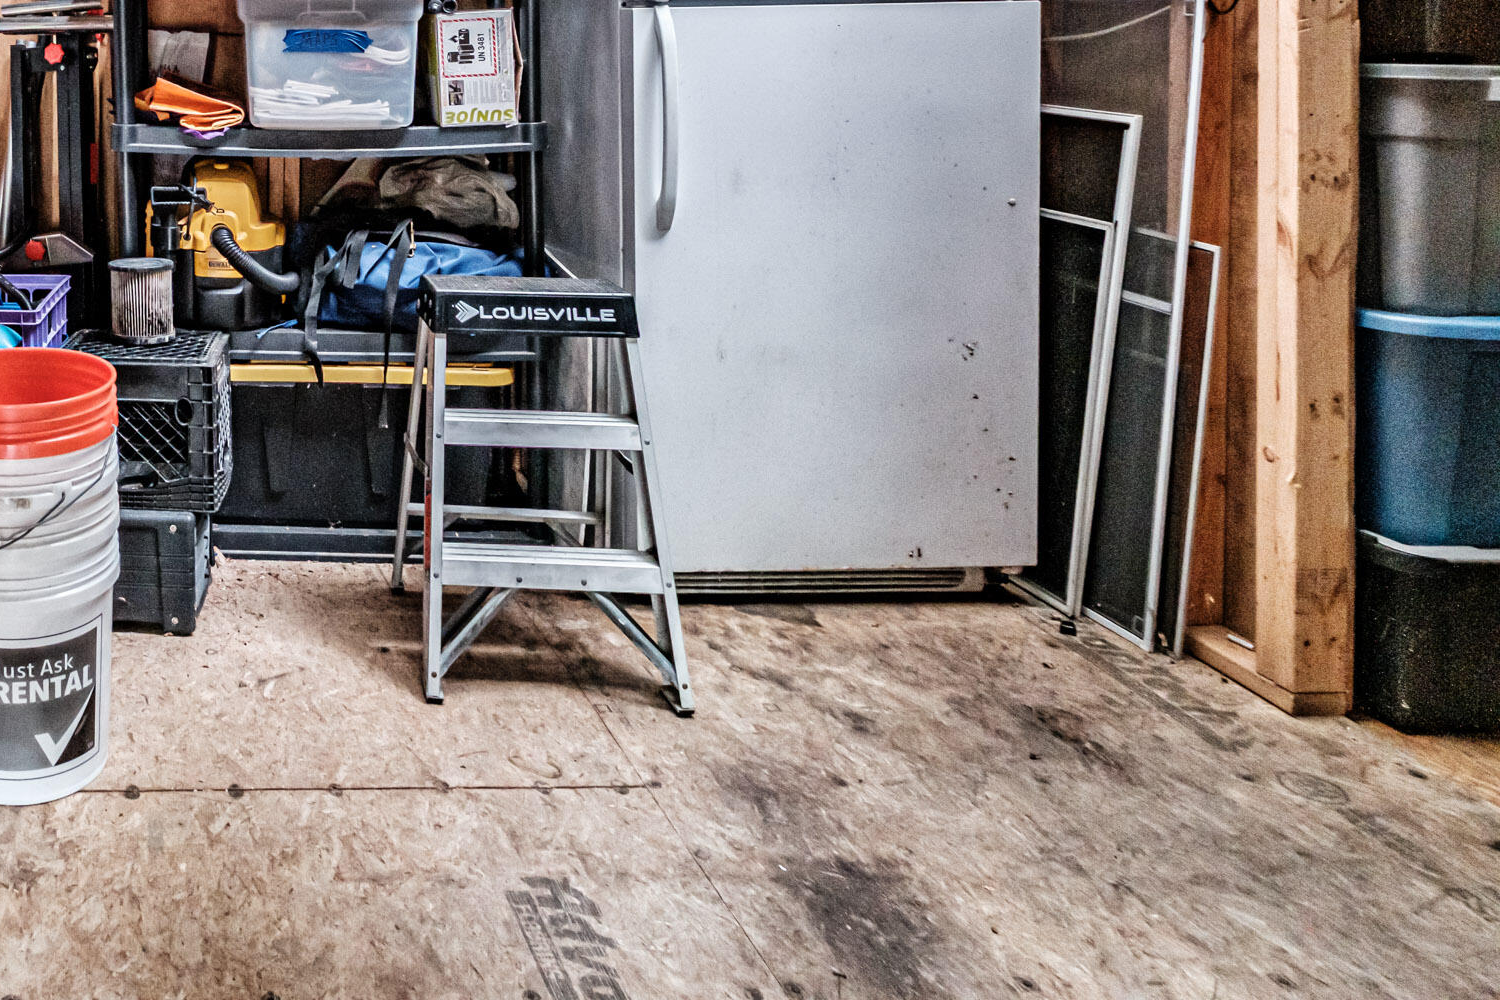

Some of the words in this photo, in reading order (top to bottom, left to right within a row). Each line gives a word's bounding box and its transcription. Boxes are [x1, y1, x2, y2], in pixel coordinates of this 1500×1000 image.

[477, 33, 485, 51] 3481
[477, 51, 486, 62] UN
[479, 305, 617, 322] LOUISVILLE
[40, 653, 74, 676] Ask
